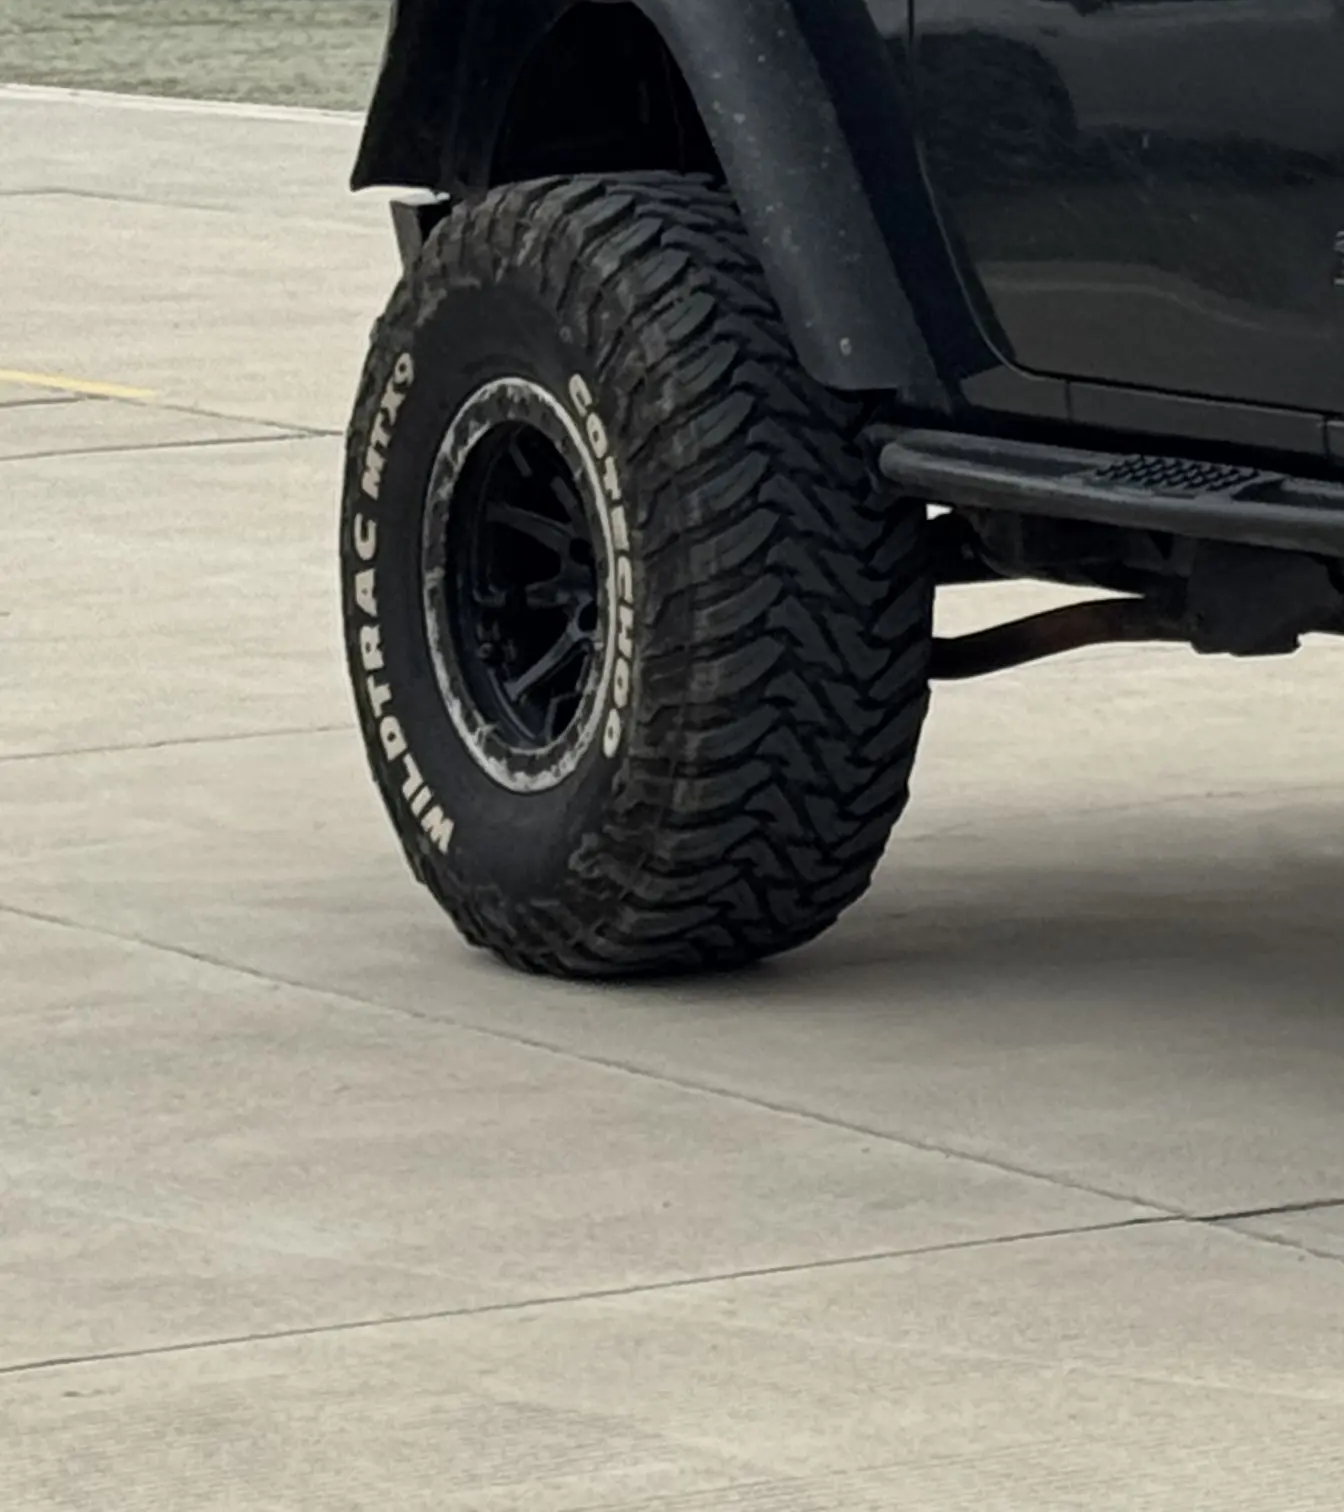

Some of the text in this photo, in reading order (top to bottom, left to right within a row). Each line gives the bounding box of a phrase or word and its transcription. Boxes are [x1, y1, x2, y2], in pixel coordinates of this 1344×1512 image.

[353, 351, 456, 854] WILDTRAC MTX9
[567, 373, 633, 758] COTECHOO
